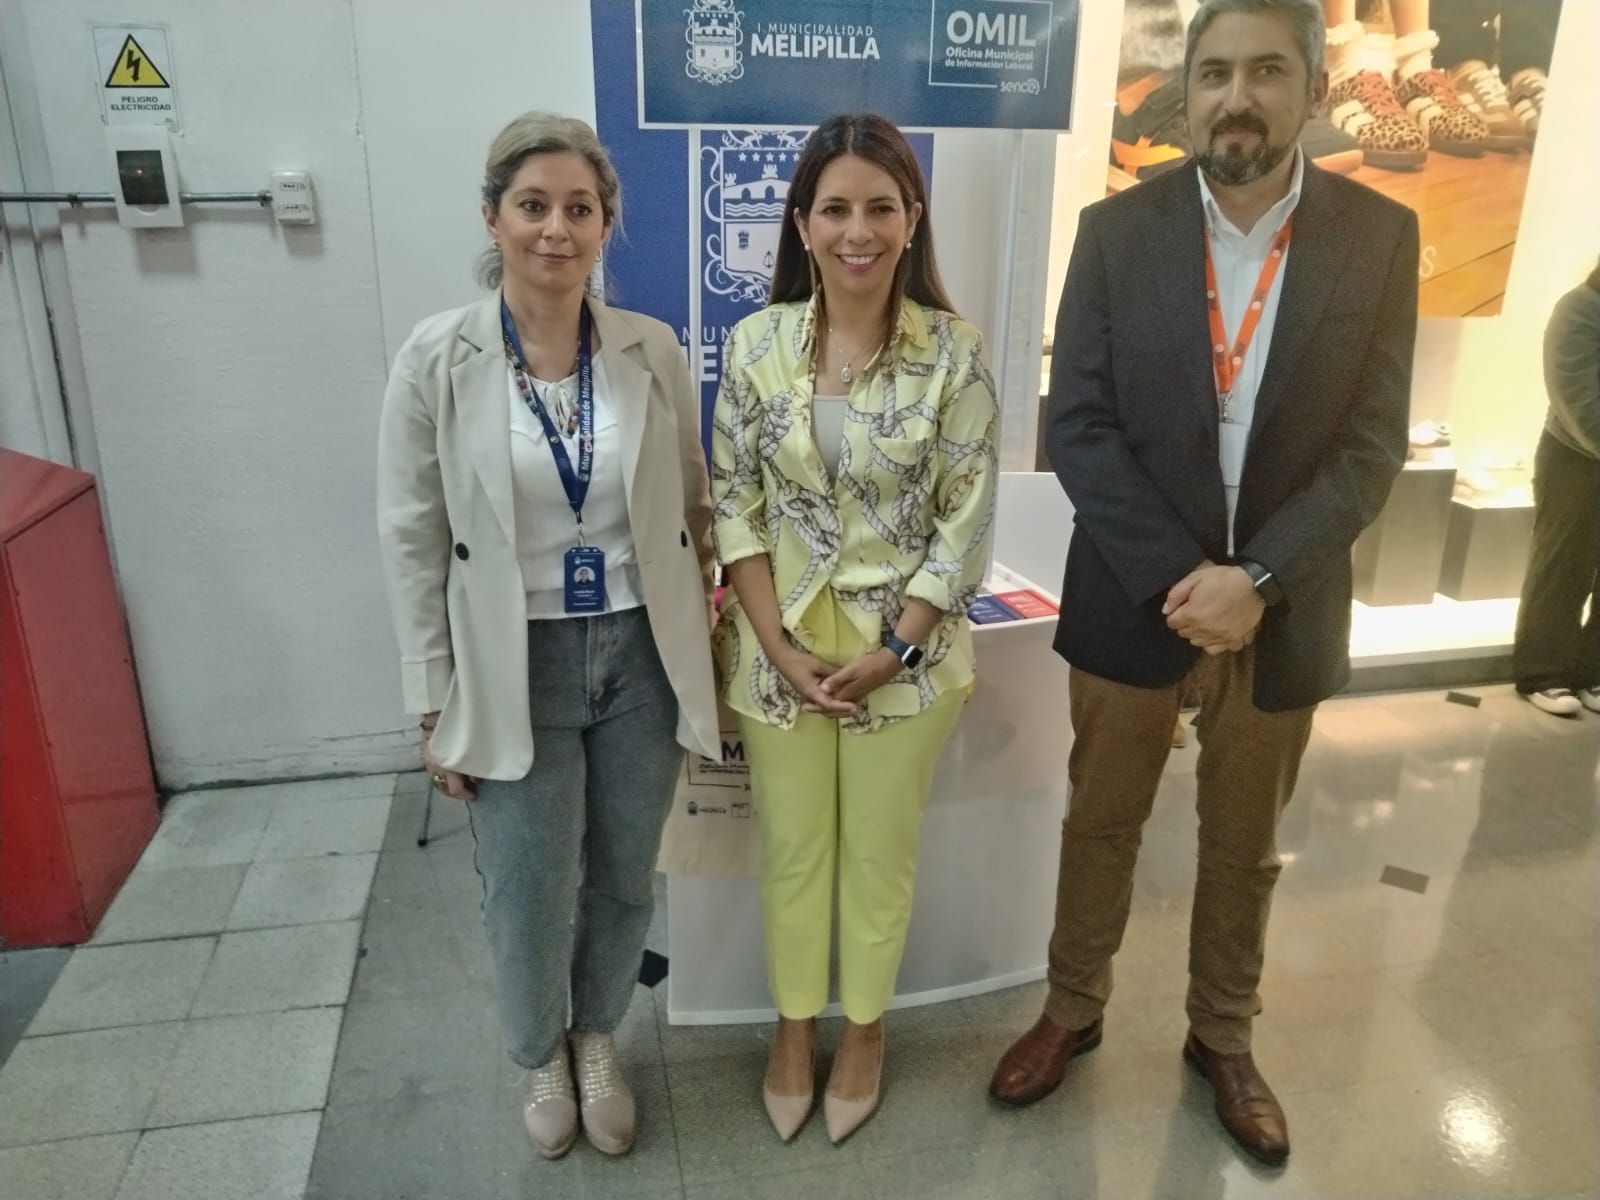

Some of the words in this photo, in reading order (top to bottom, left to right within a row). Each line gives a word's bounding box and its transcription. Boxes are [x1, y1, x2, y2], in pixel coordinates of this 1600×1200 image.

[768, 23, 873, 36] MUNICIPALIDAD
[946, 10, 1036, 47] OMIL
[750, 33, 881, 60] MELIPILLA
[945, 46, 982, 59] Oficina
[984, 47, 1034, 62] Municipal
[945, 59, 955, 67] de
[956, 59, 1003, 69] Información
[1004, 61, 1033, 70] Laboral
[581, 365, 592, 399] Melipilla
[582, 400, 591, 410] de
